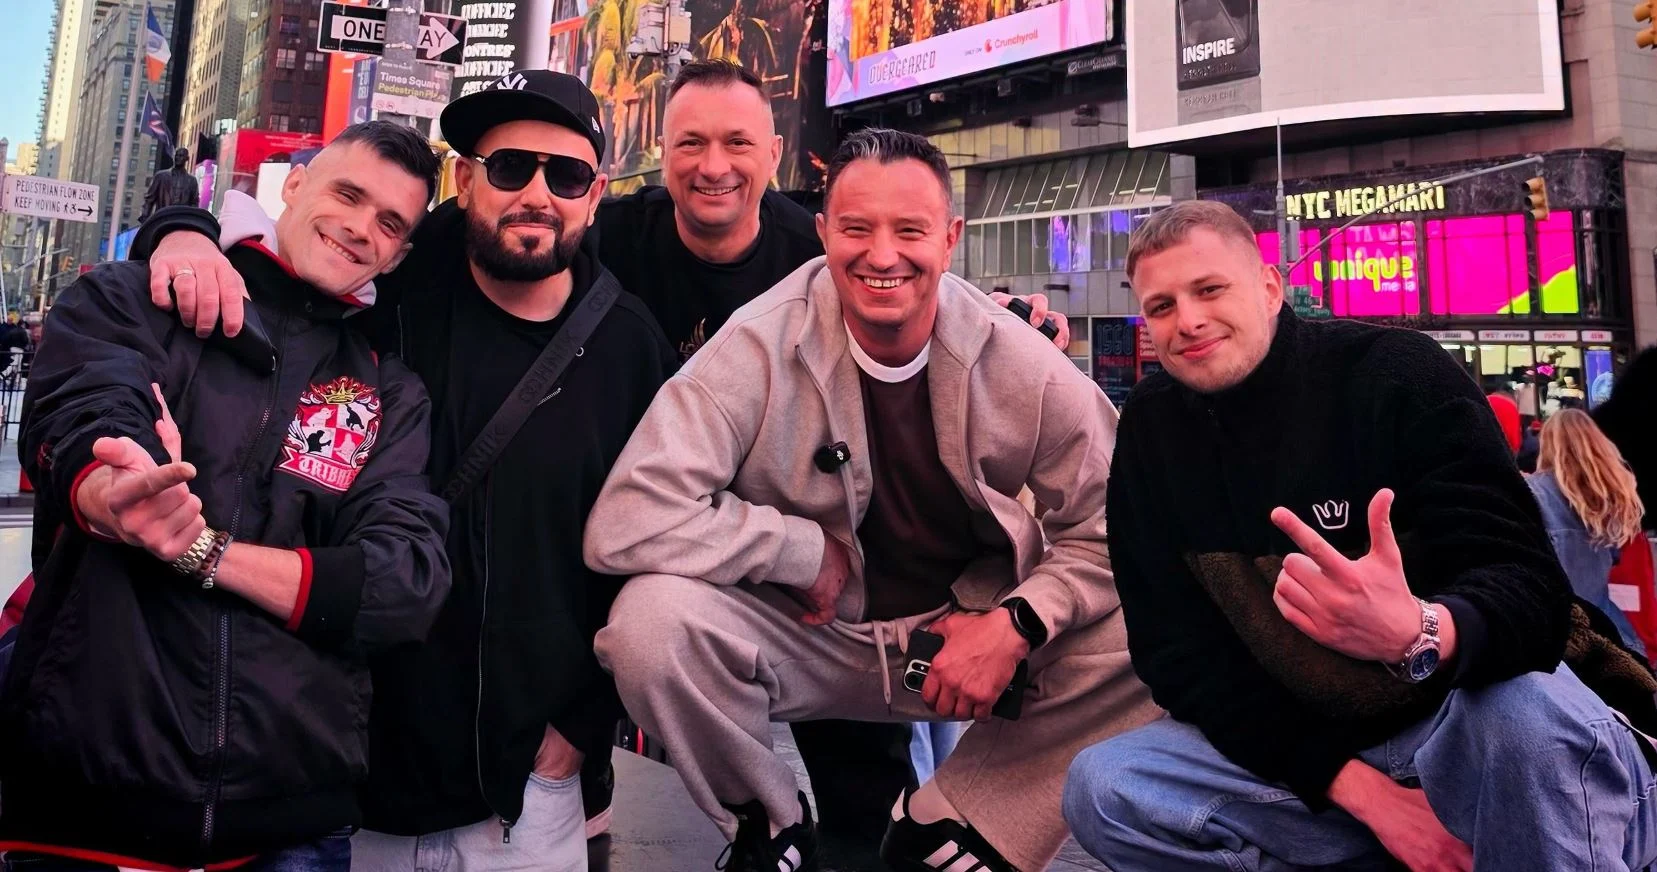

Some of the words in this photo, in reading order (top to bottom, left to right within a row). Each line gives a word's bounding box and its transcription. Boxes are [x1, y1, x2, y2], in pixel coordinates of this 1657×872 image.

[343, 20, 386, 41] ONE
[420, 30, 447, 48] AY
[994, 29, 1038, 49] Crunchyroll
[1182, 37, 1236, 65] INSPIRE
[378, 82, 425, 97] Pedestrian
[380, 71, 408, 85] Times
[408, 76, 441, 90] Square
[16, 180, 58, 196] PEDESTRIAN
[60, 186, 77, 199] FLOW
[78, 189, 95, 201] ZONE
[15, 195, 32, 208] KEEP
[35, 199, 61, 213] MOVING
[1286, 190, 1332, 221] NYC
